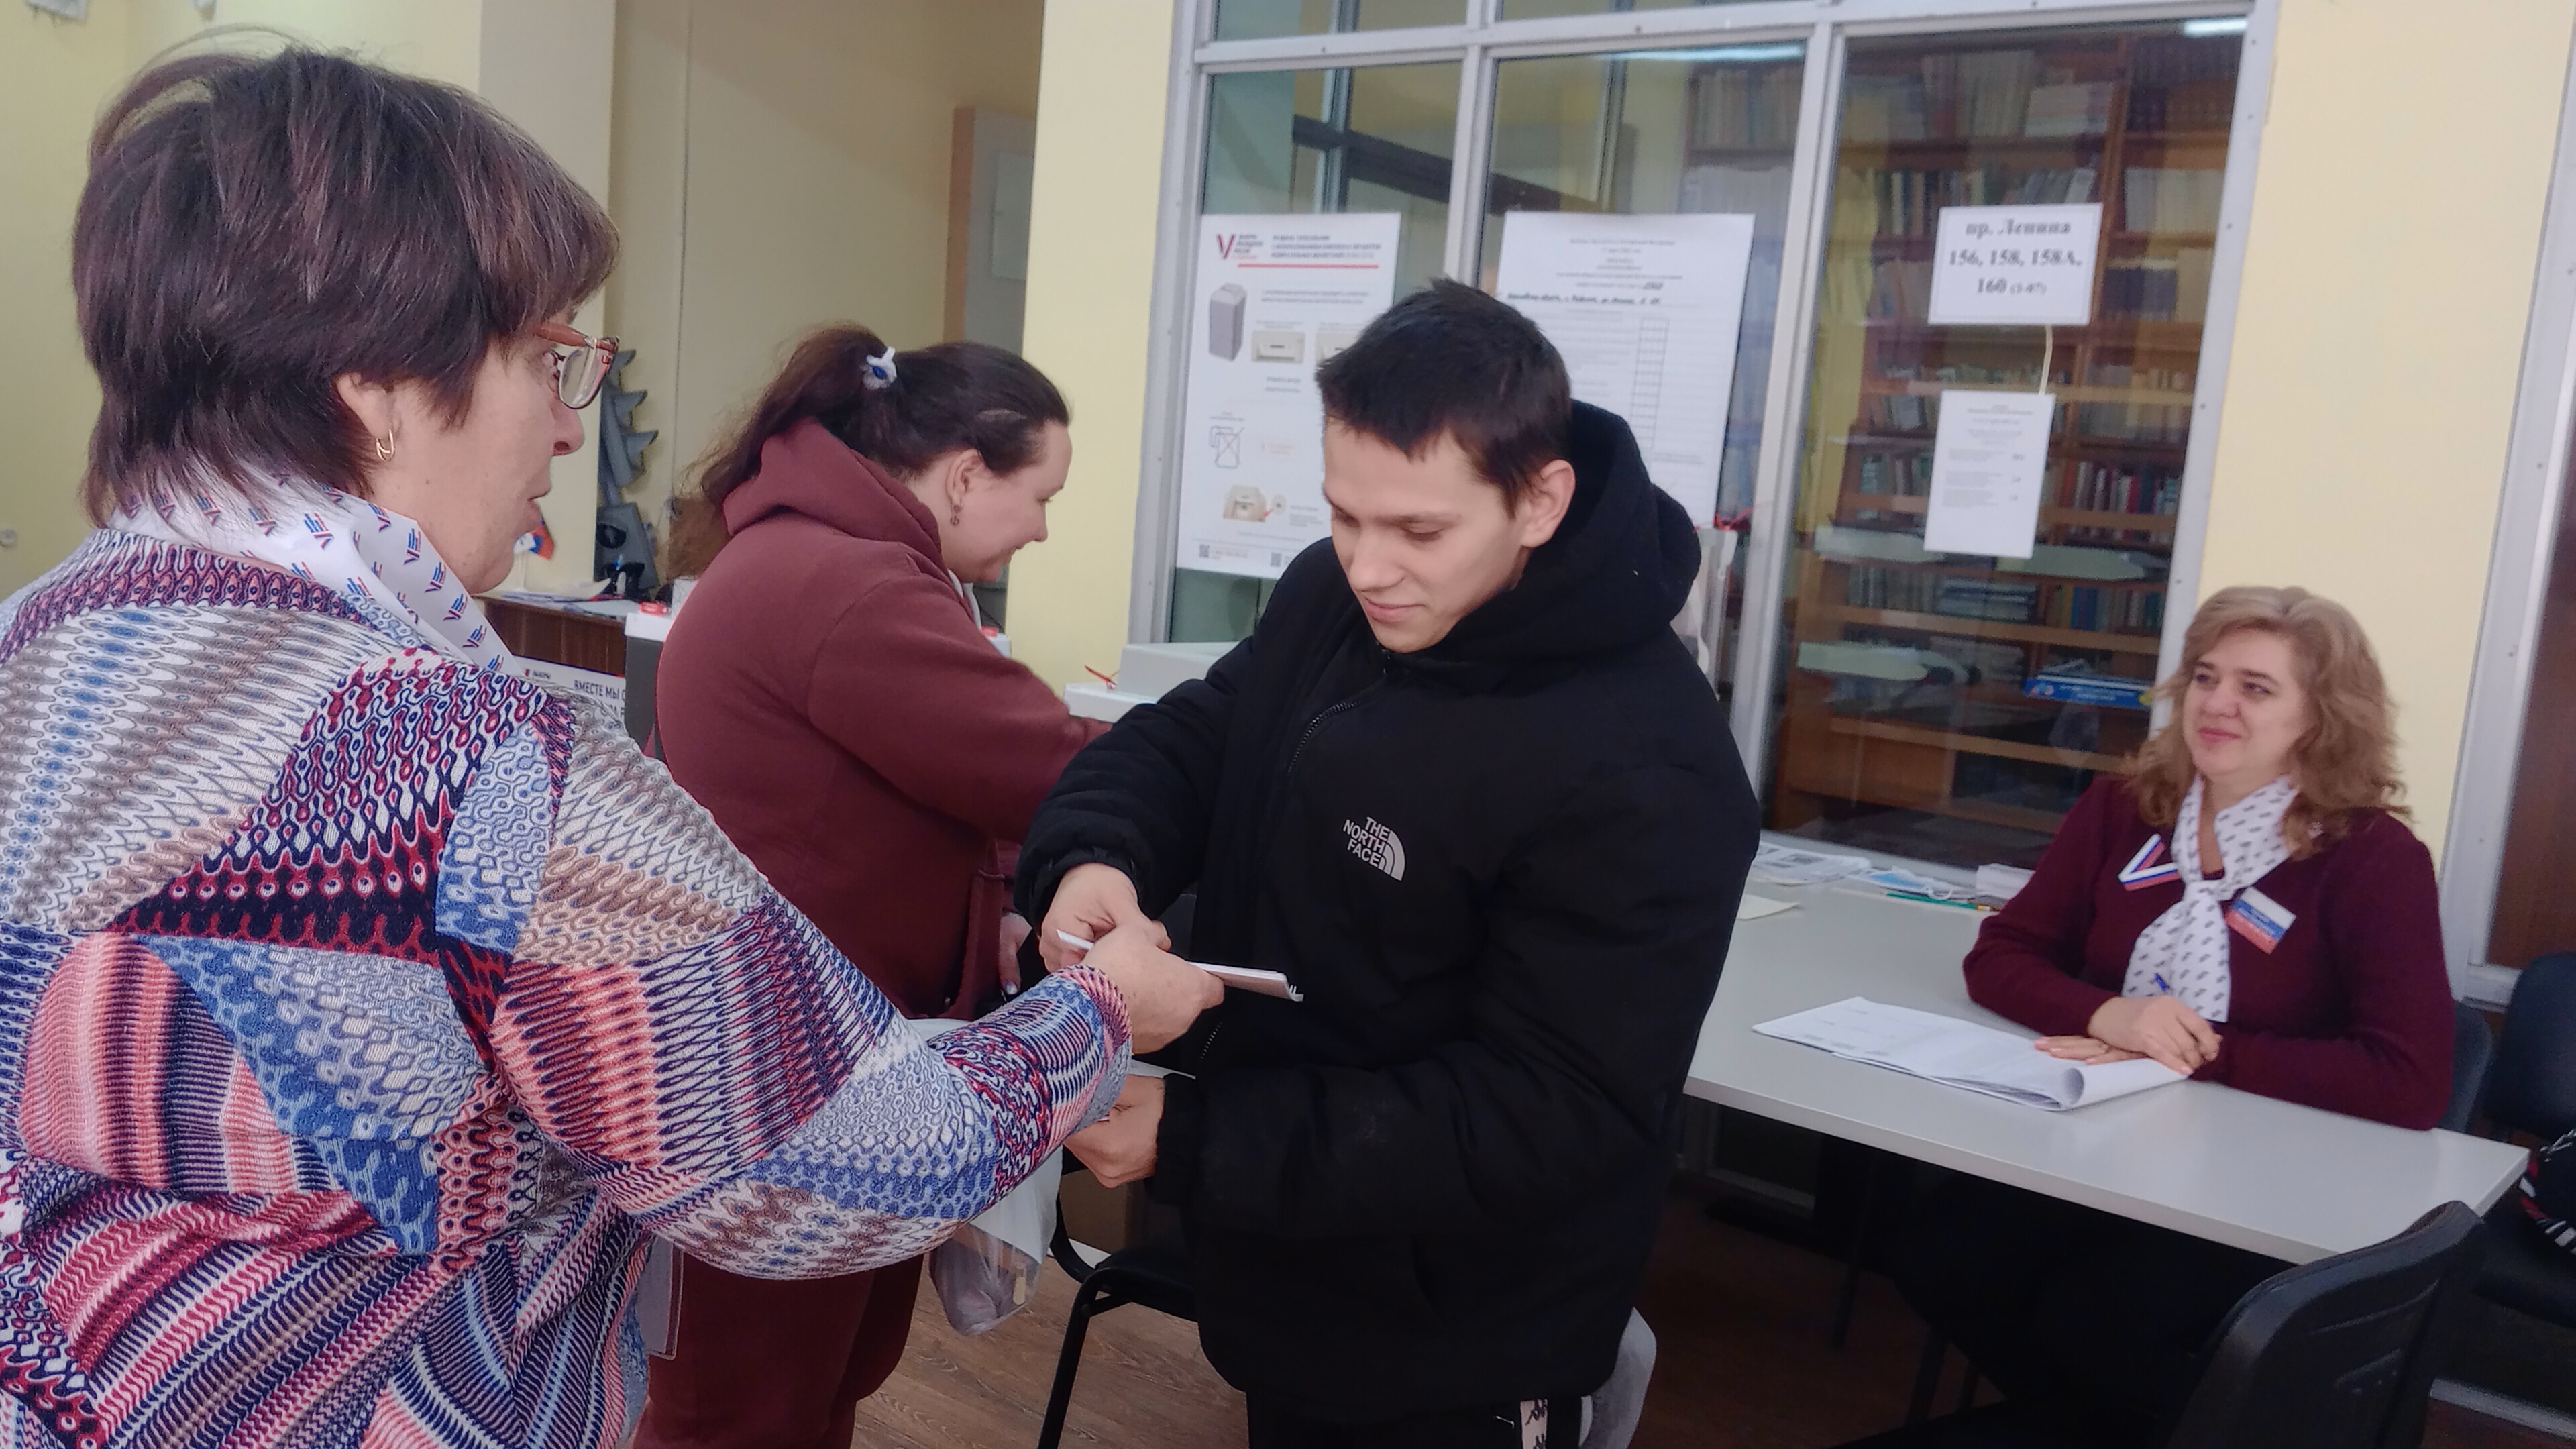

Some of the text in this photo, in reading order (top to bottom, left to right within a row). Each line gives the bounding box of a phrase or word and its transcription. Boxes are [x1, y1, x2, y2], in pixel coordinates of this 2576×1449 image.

[1966, 217, 2071, 239] пр. Ленина
[1949, 248, 1984, 266] 156,
[1990, 248, 2025, 266] 158,
[1977, 277, 2008, 294] 160
[574, 679, 604, 697] ВМЕСТЕ
[605, 686, 620, 700] МЫ
[1343, 819, 1385, 854] NORTH
[1365, 816, 1390, 841] THE
[1347, 838, 1381, 867] FACE
